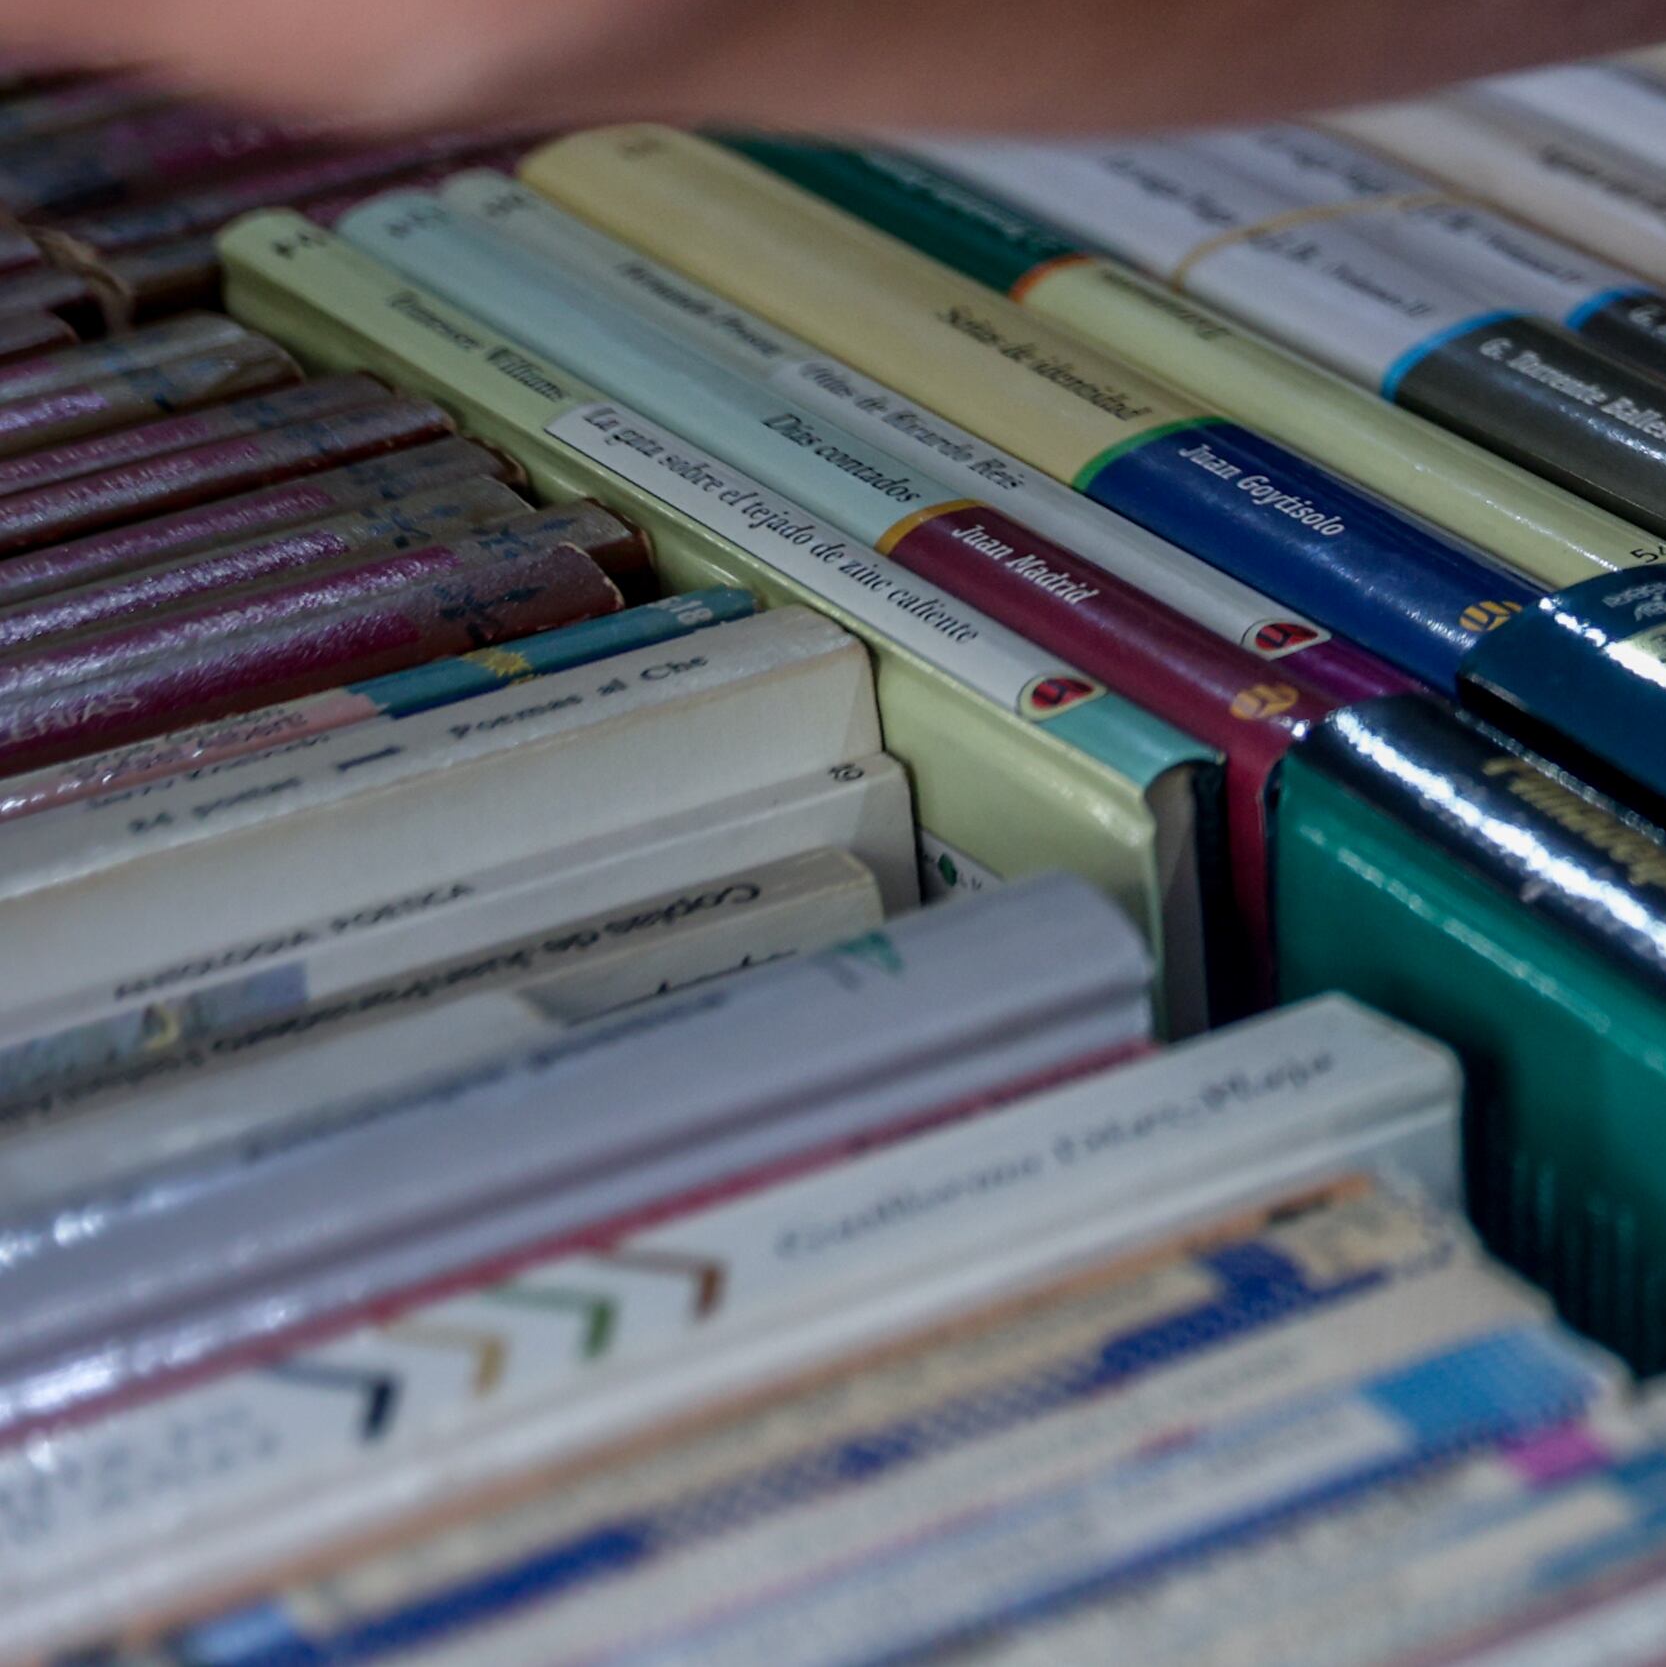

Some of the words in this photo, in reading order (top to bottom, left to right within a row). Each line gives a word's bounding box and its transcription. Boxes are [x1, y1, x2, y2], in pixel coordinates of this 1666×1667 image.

[486, 346, 568, 402] Williams
[1005, 339, 1042, 363] de
[1033, 354, 1155, 422] identidad
[1507, 349, 1608, 405] Torrente
[762, 412, 819, 447] Días
[814, 445, 928, 506] contados
[967, 450, 1026, 492] Reis
[1180, 443, 1237, 480] Juan
[1237, 473, 1347, 536] Goytisolo
[584, 407, 617, 432] La
[610, 428, 660, 458] gata
[660, 450, 723, 492] sobre
[723, 486, 753, 511] el
[743, 494, 812, 548] tejado
[812, 536, 847, 565] de
[840, 555, 892, 593] zinc
[888, 578, 979, 644] caliente
[952, 524, 1007, 562] Juan
[1007, 550, 1099, 604] Madrid
[449, 690, 582, 738] Poemas
[638, 653, 711, 683] Che
[603, 882, 763, 937] Coplas
